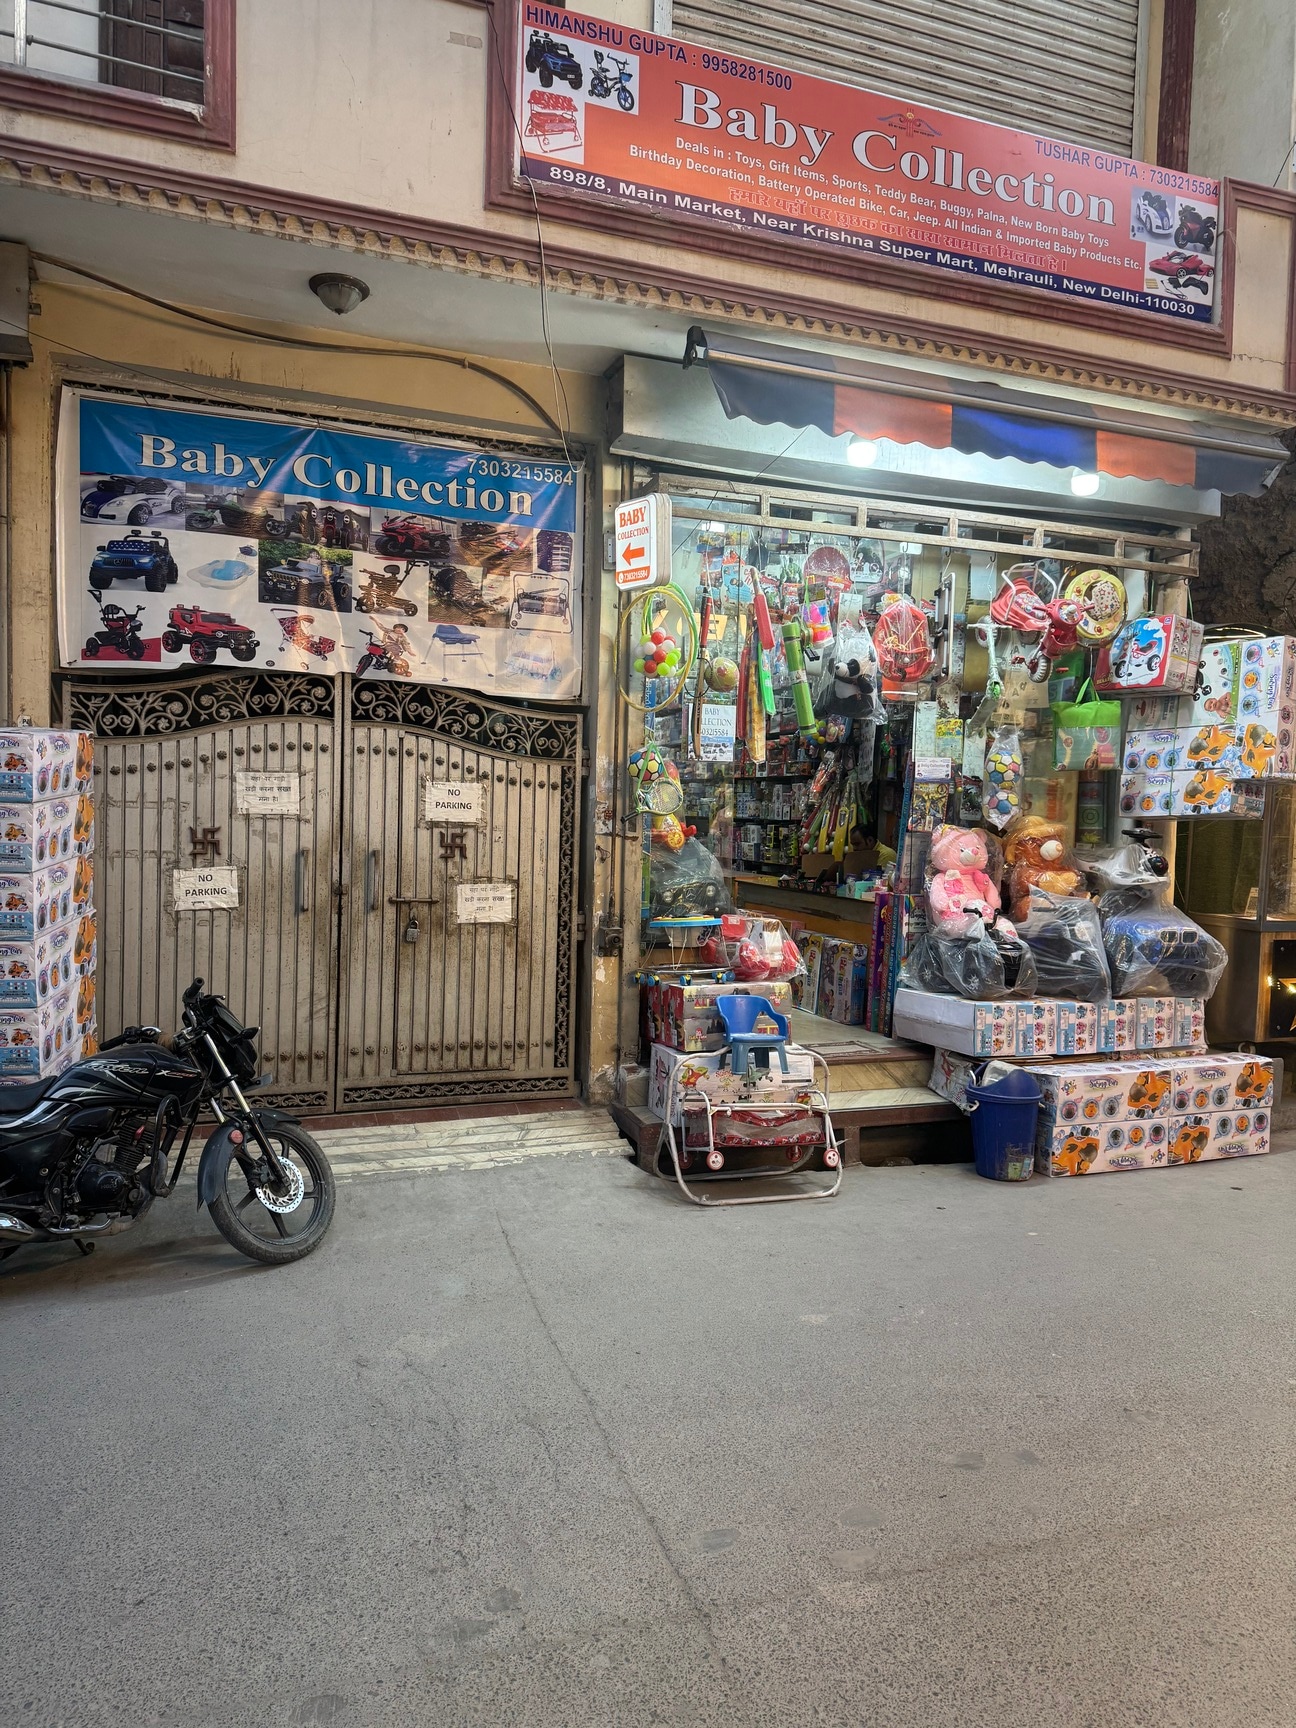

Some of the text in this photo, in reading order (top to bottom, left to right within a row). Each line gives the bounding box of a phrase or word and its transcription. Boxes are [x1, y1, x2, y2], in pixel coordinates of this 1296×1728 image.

[526, 4, 623, 46] HIMANSHU
[629, 33, 687, 64] GUPTA
[702, 52, 793, 90] 9958281500
[675, 80, 1117, 227] Baby Collection
[1035, 140, 1090, 167] TUSHAR
[1094, 155, 1138, 179] GUPTA
[1149, 169, 1219, 198] 7303215584
[629, 145, 682, 170] Birthday
[686, 157, 754, 187] Decoration,
[759, 175, 801, 199] Battery
[804, 186, 855, 210] Operated
[859, 198, 886, 216] Bike,
[889, 205, 911, 222] Car,
[945, 217, 958, 230] All
[961, 220, 992, 239] Indian
[995, 228, 1003, 240] &
[1006, 230, 1051, 253] Imported
[1053, 239, 1078, 259] Baby
[1080, 247, 1121, 266] Products
[1124, 256, 1142, 271] Etc.
[676, 137, 710, 158] Deals
[713, 145, 724, 159] in
[735, 151, 765, 171] Toys,
[769, 159, 790, 177] Gift
[793, 165, 828, 187] Items,
[832, 173, 871, 196] Sports,
[874, 184, 907, 205] Teddy
[910, 191, 936, 211] Bear,
[940, 197, 974, 219] Buggy,
[977, 205, 1007, 225] Palna,
[1011, 215, 1033, 230] New
[1036, 220, 1059, 235] Born
[1061, 225, 1087, 245] Baby
[1088, 232, 1109, 248] Toys
[550, 166, 1195, 316] 898/8, Main Market, Near Krishna Super Mart, Mehrauli, New Delhi-110030
[728, 187, 771, 208] हमारे
[810, 205, 832, 221] पर
[880, 220, 904, 237] का
[906, 226, 941, 246] सारा
[944, 233, 993, 258] सामान
[996, 243, 1044, 268] मिलता
[137, 433, 534, 517] Baby Collection
[467, 457, 574, 486] 7303215584
[617, 525, 649, 541] COLLECTION
[619, 506, 646, 528] BABY
[704, 707, 720, 716] BABY
[435, 801, 472, 810] PARKING
[447, 789, 461, 797] NO
[185, 887, 227, 897] PARKING
[198, 874, 213, 882] NO
